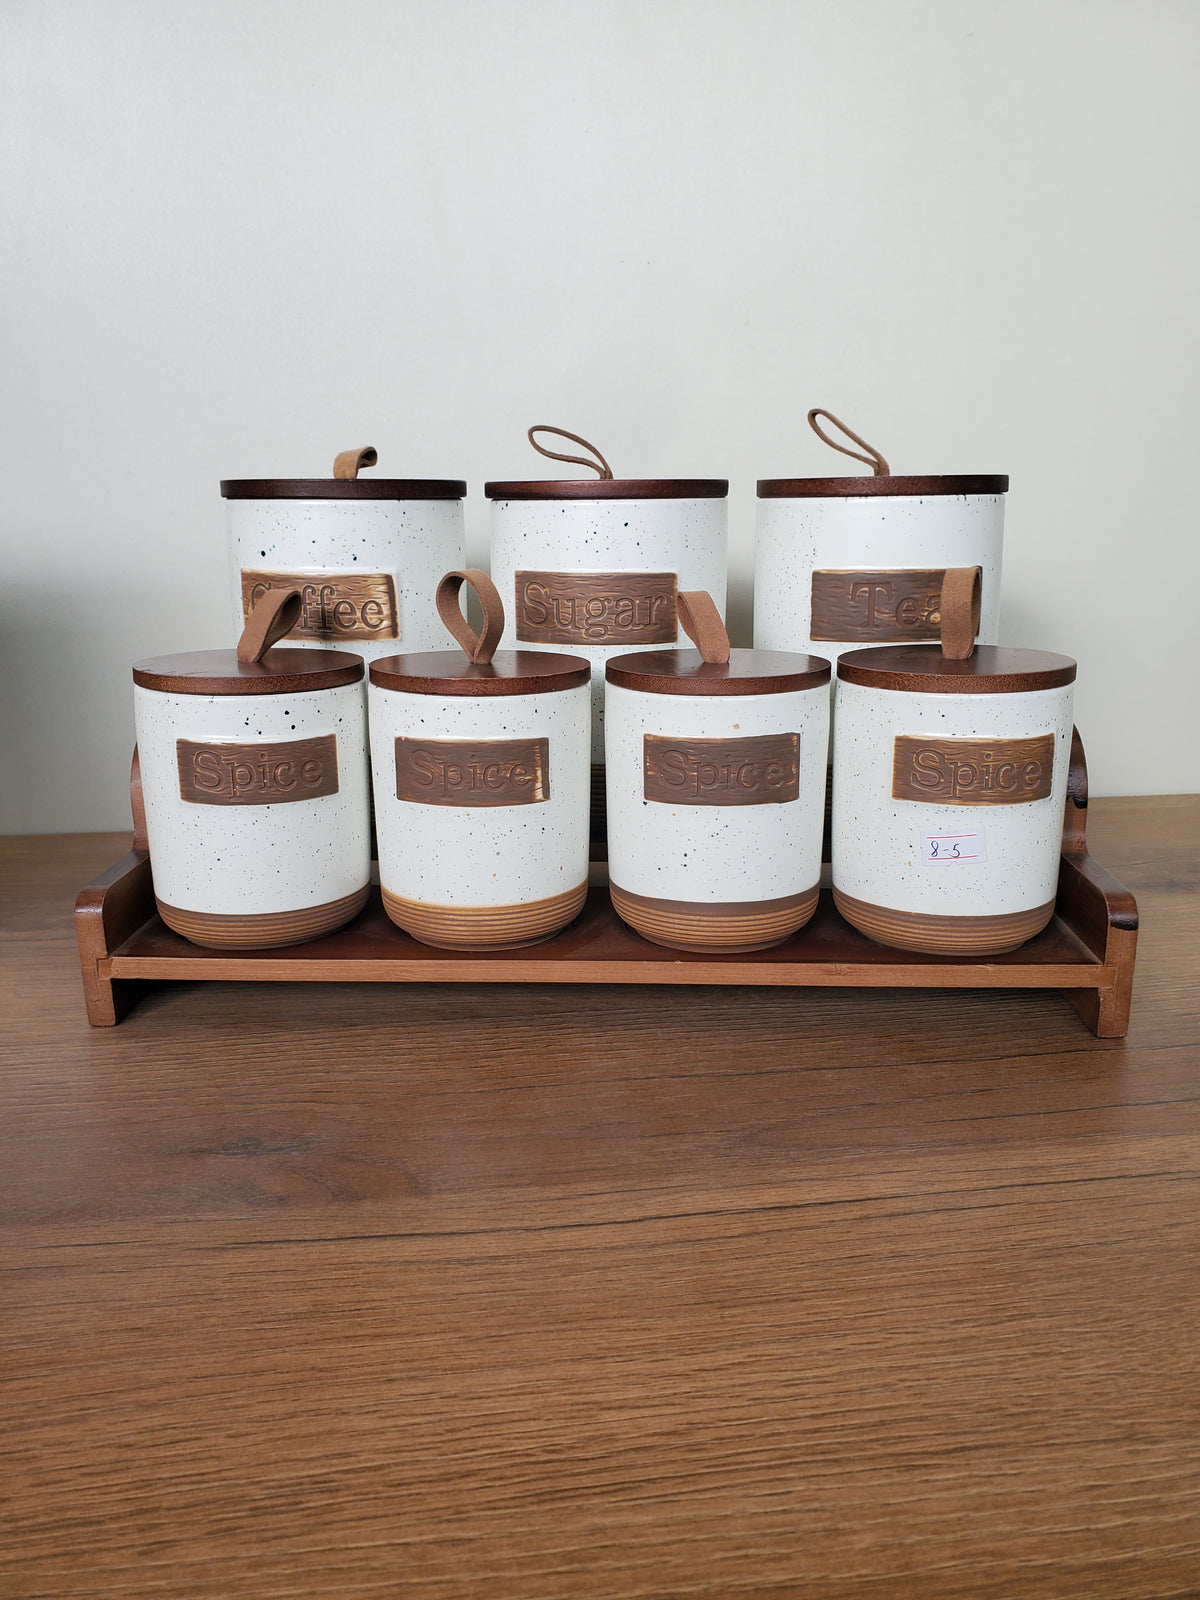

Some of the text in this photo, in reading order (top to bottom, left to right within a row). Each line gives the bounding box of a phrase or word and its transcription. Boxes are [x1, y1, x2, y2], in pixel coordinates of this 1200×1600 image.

[524, 581, 667, 639] Sugar
[193, 751, 323, 800] Spice
[410, 749, 534, 798] Spice
[661, 749, 785, 798] Spice
[911, 748, 1042, 799] Spice
[930, 840, 961, 858] 8-5
